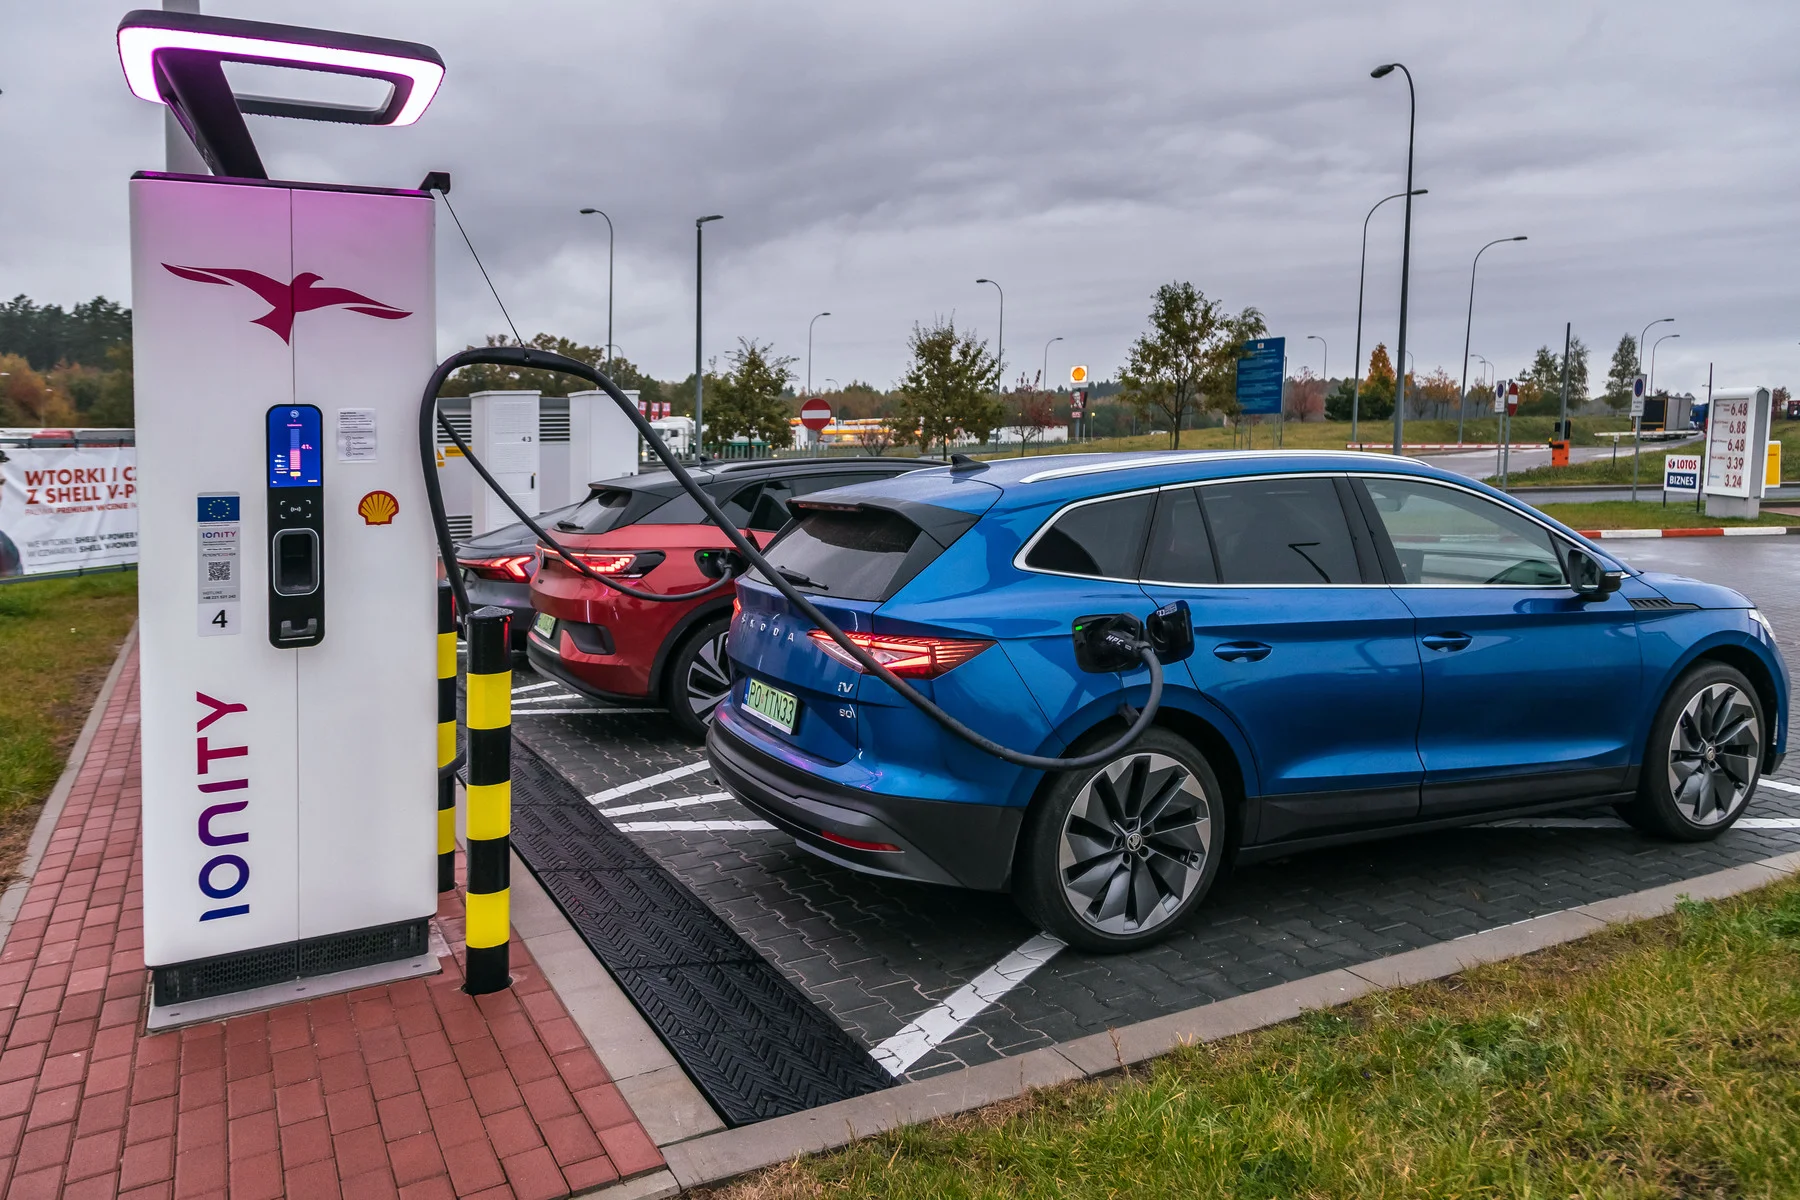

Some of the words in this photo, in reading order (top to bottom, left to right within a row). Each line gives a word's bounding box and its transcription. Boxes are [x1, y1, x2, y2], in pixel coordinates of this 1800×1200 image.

[1731, 403, 1748, 416] 6.48
[1729, 421, 1746, 434] 6.88
[1727, 439, 1745, 452] 6.48
[1677, 459, 1697, 470] LOTOS
[1726, 456, 1744, 470] 3.39
[24, 467, 106, 487] WTORKI
[112, 466, 117, 482] I
[122, 466, 137, 482] C
[1669, 475, 1694, 486] BIZNES
[1724, 474, 1742, 488] 3.24
[26, 488, 39, 505] Z
[45, 486, 101, 504] SHELL
[106, 484, 137, 500] V-P
[202, 531, 236, 539] IONITY
[211, 609, 229, 628] 4
[748, 681, 763, 709] PO
[763, 688, 795, 725] 1TN33
[196, 690, 251, 923] IONITY
